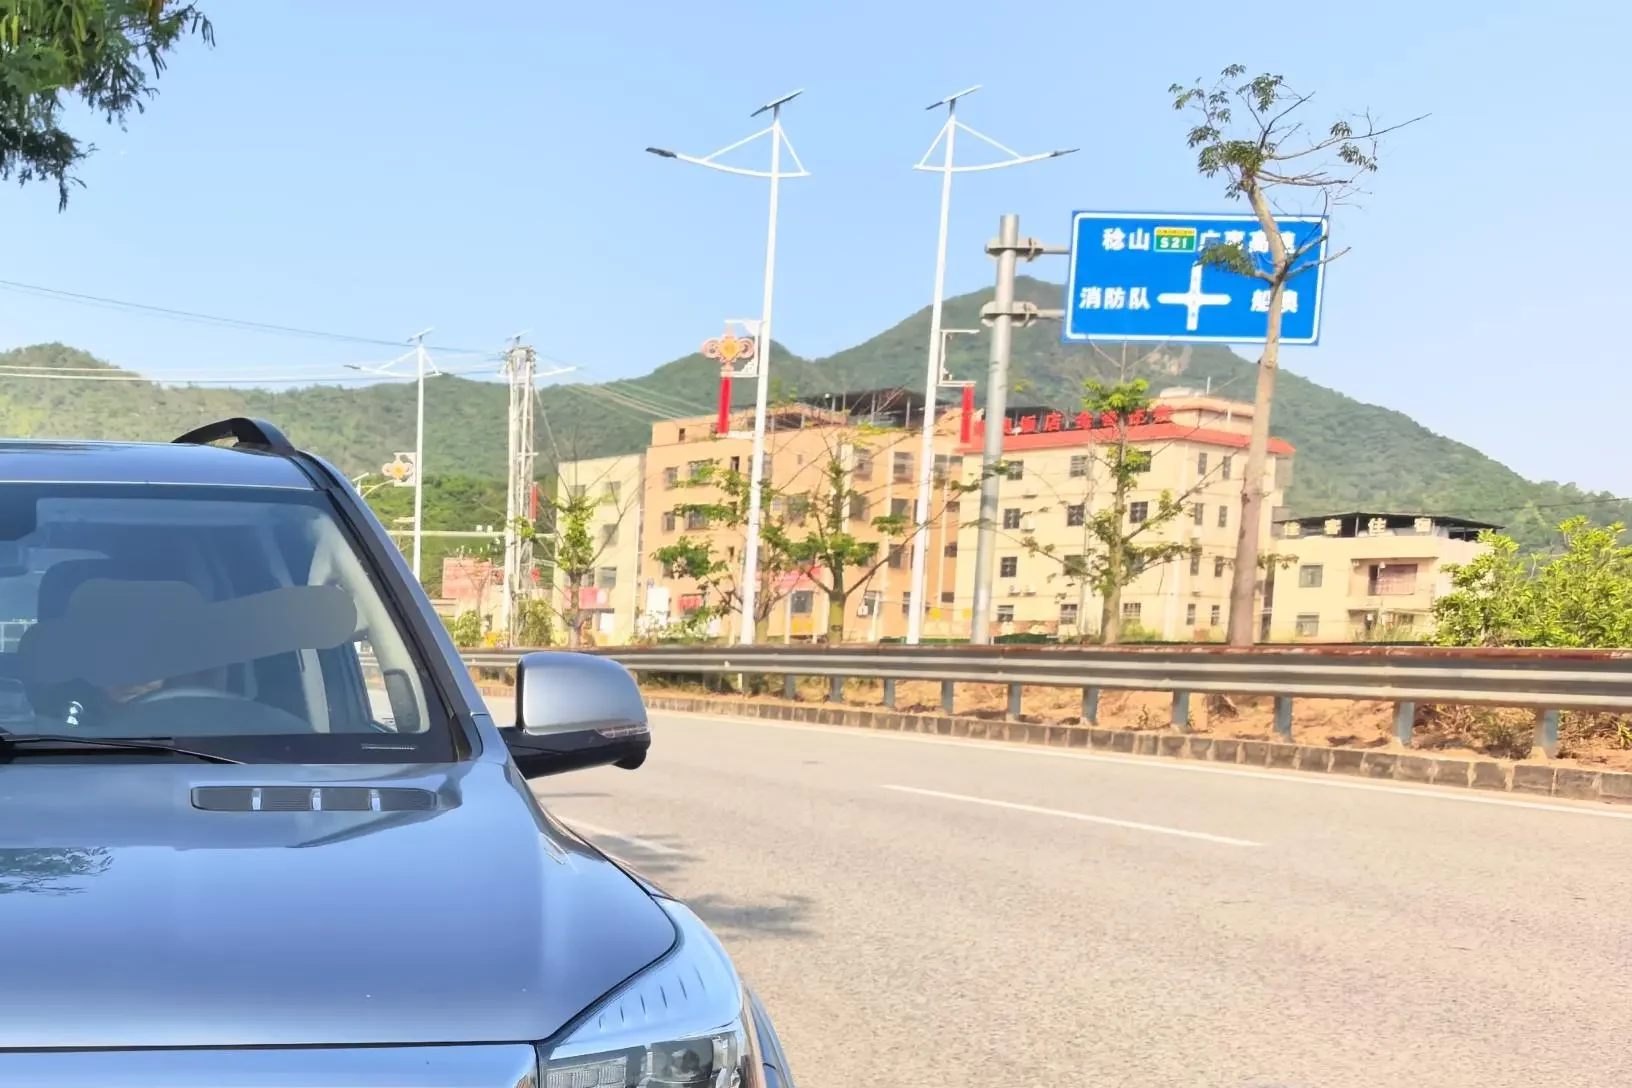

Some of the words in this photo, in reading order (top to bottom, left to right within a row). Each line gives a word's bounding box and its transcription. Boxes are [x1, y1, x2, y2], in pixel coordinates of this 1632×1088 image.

[1159, 236, 1188, 249] S21
[1079, 286, 1151, 310] 消防队
